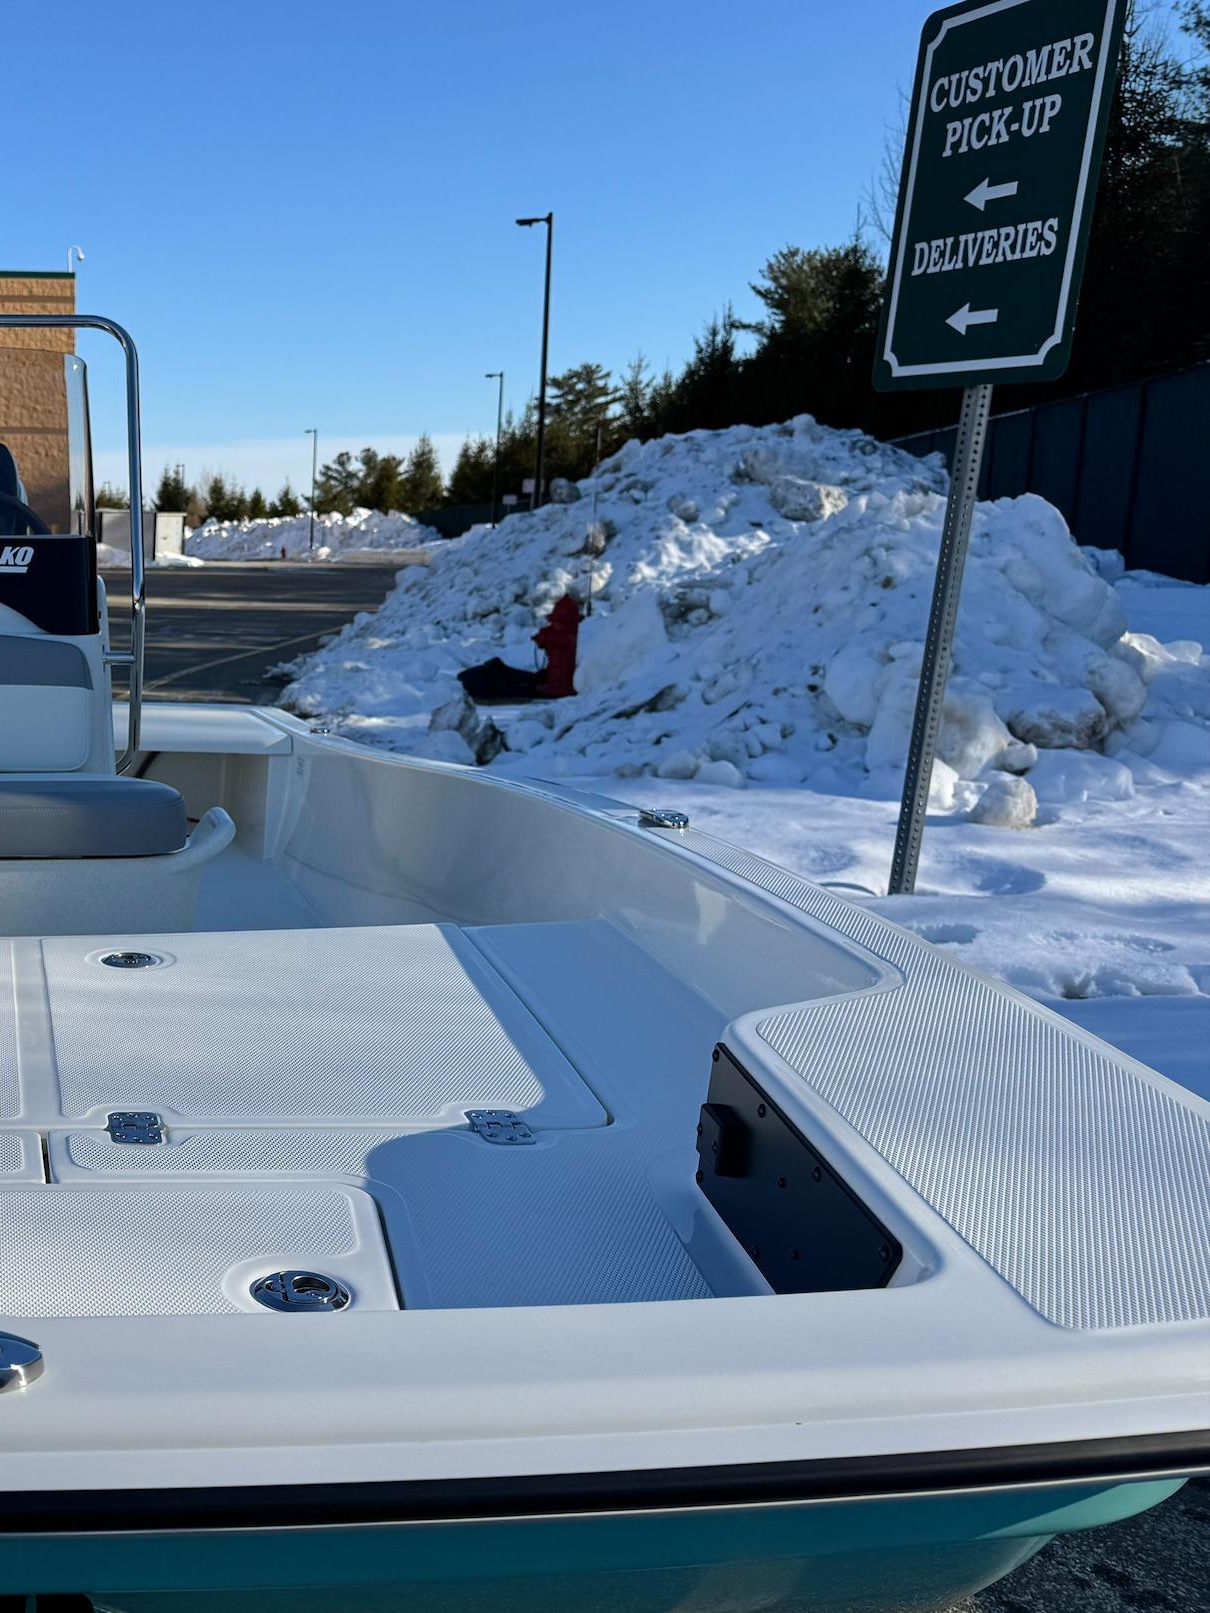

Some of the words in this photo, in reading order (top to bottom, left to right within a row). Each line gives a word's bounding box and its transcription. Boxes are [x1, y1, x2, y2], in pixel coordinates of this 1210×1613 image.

[930, 33, 1094, 113] CUSTOMER
[942, 94, 1062, 157] PICK-UP
[911, 218, 1058, 276] DELIVERIES
